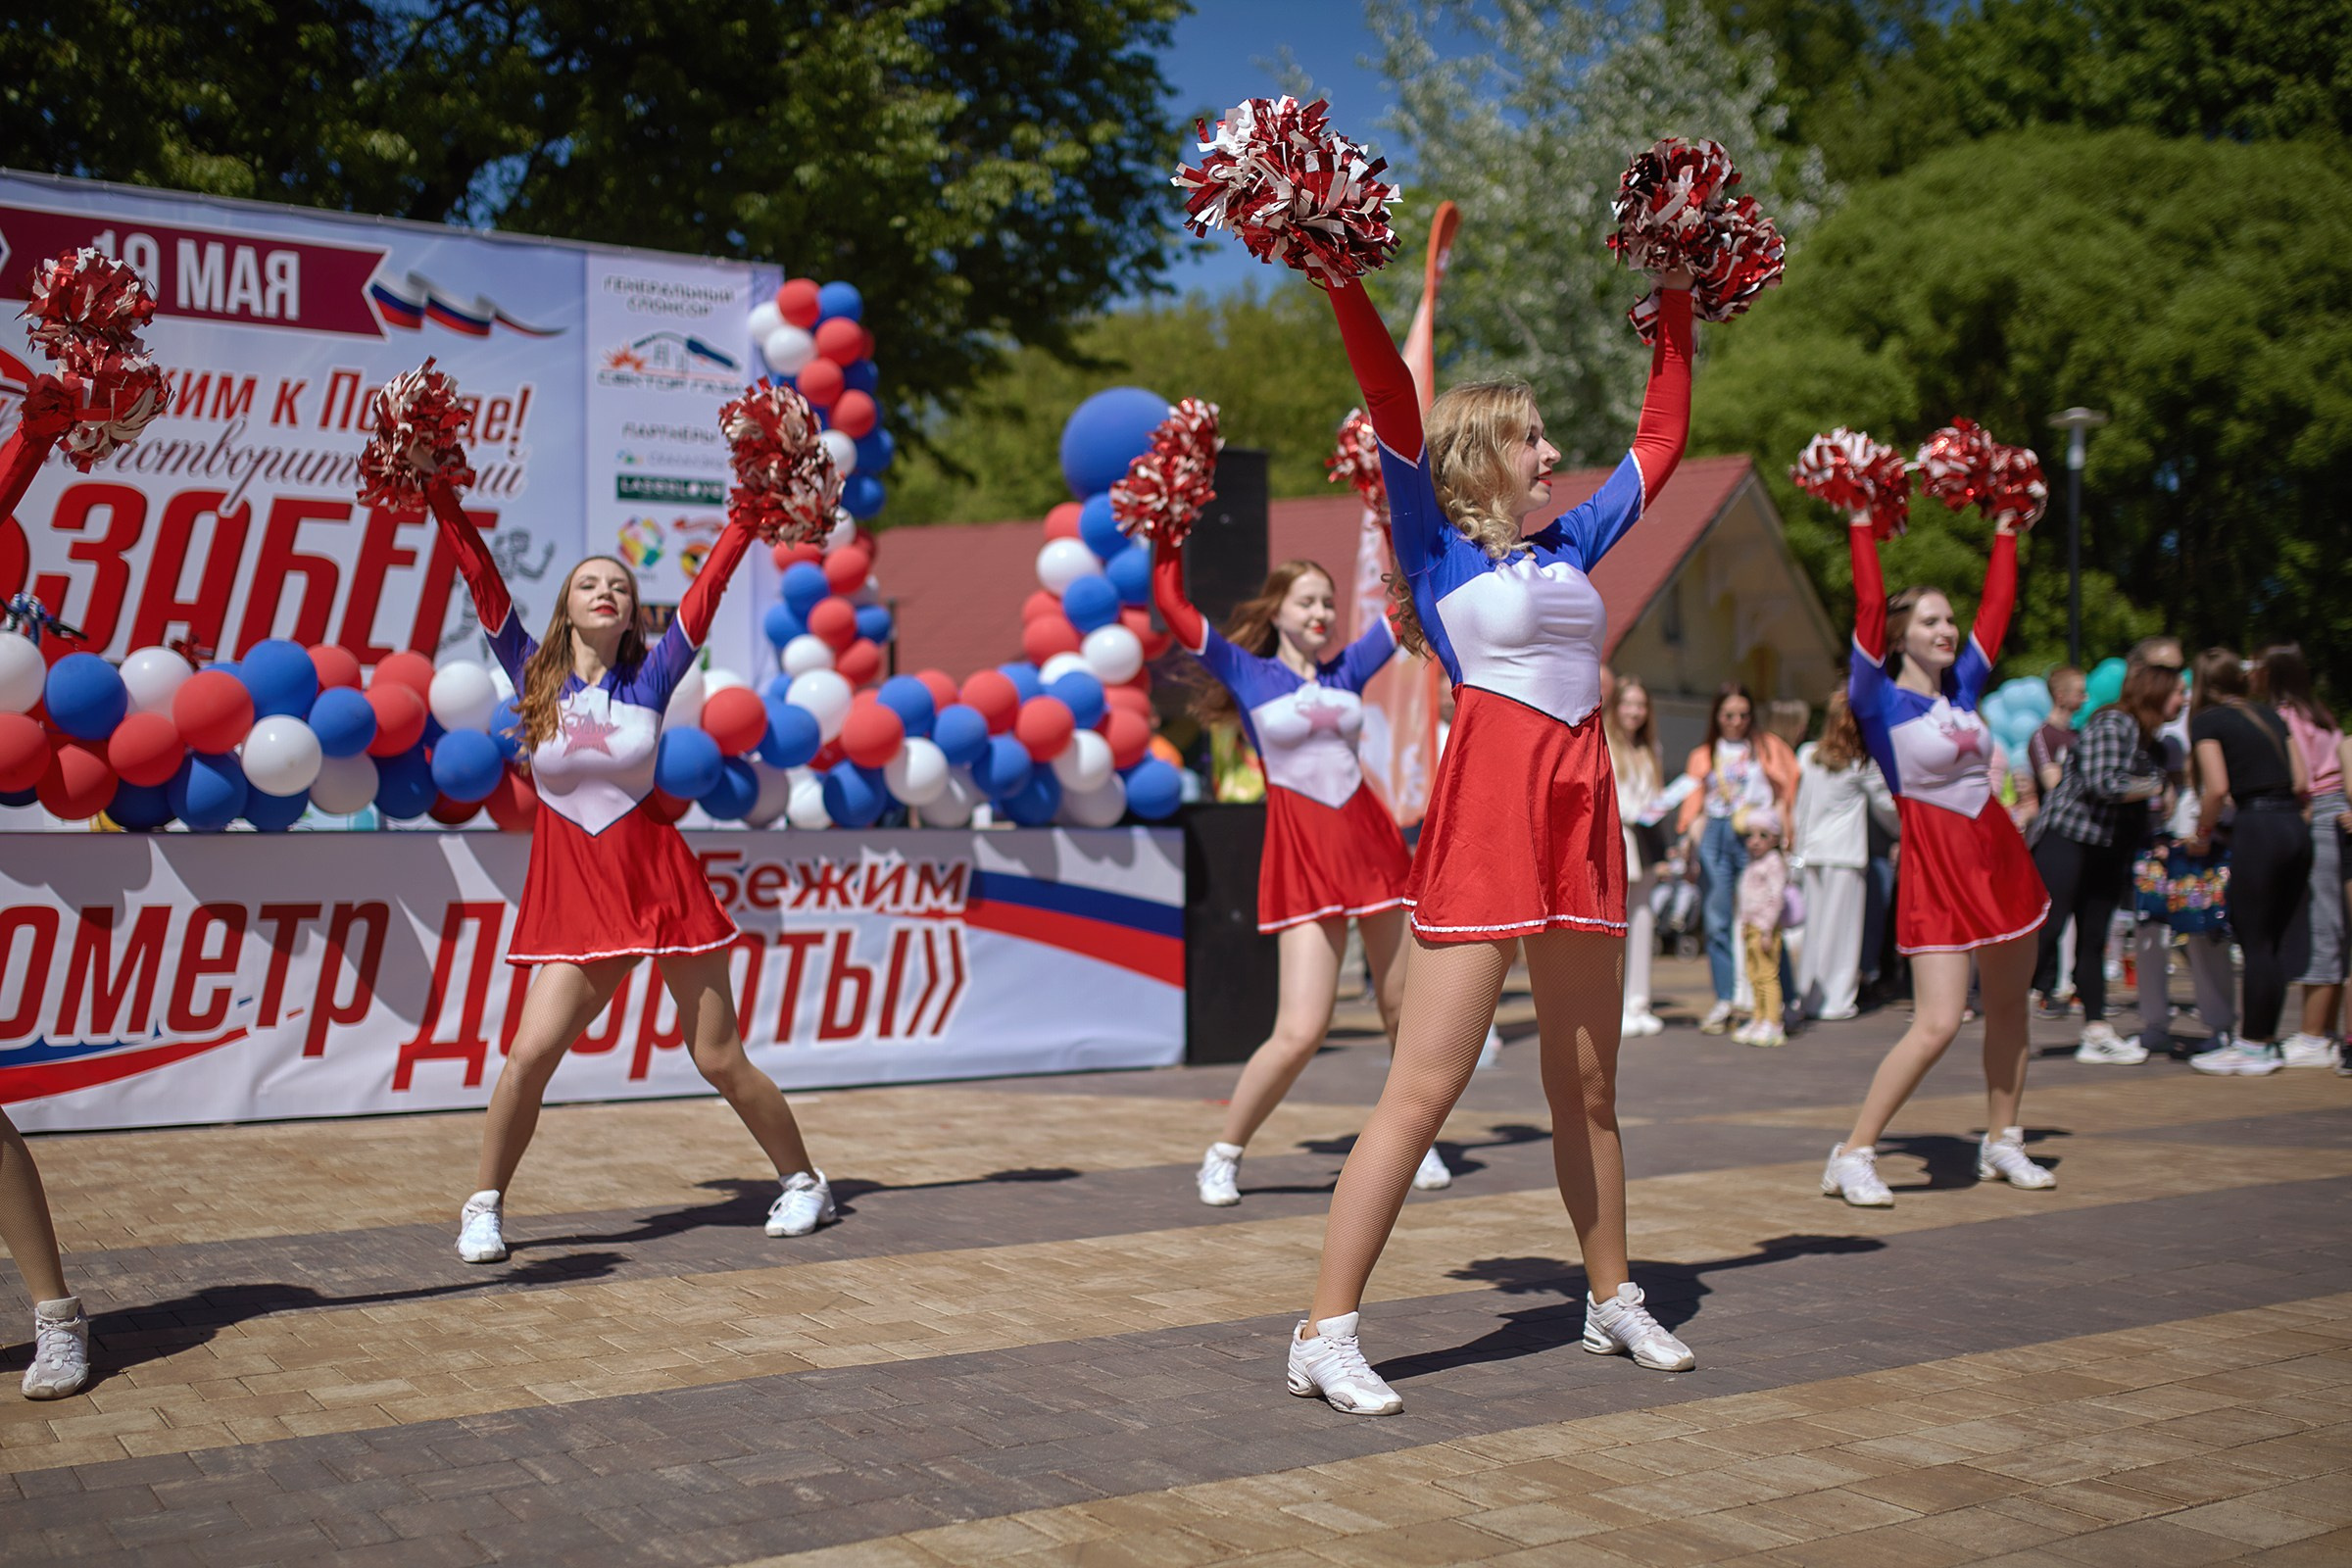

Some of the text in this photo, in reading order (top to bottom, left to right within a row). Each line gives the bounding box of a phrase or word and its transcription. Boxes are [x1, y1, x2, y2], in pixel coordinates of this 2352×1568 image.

[176, 237, 300, 320] МАЯ
[318, 370, 531, 447] Поде!
[392, 901, 965, 1092] Дроты»
